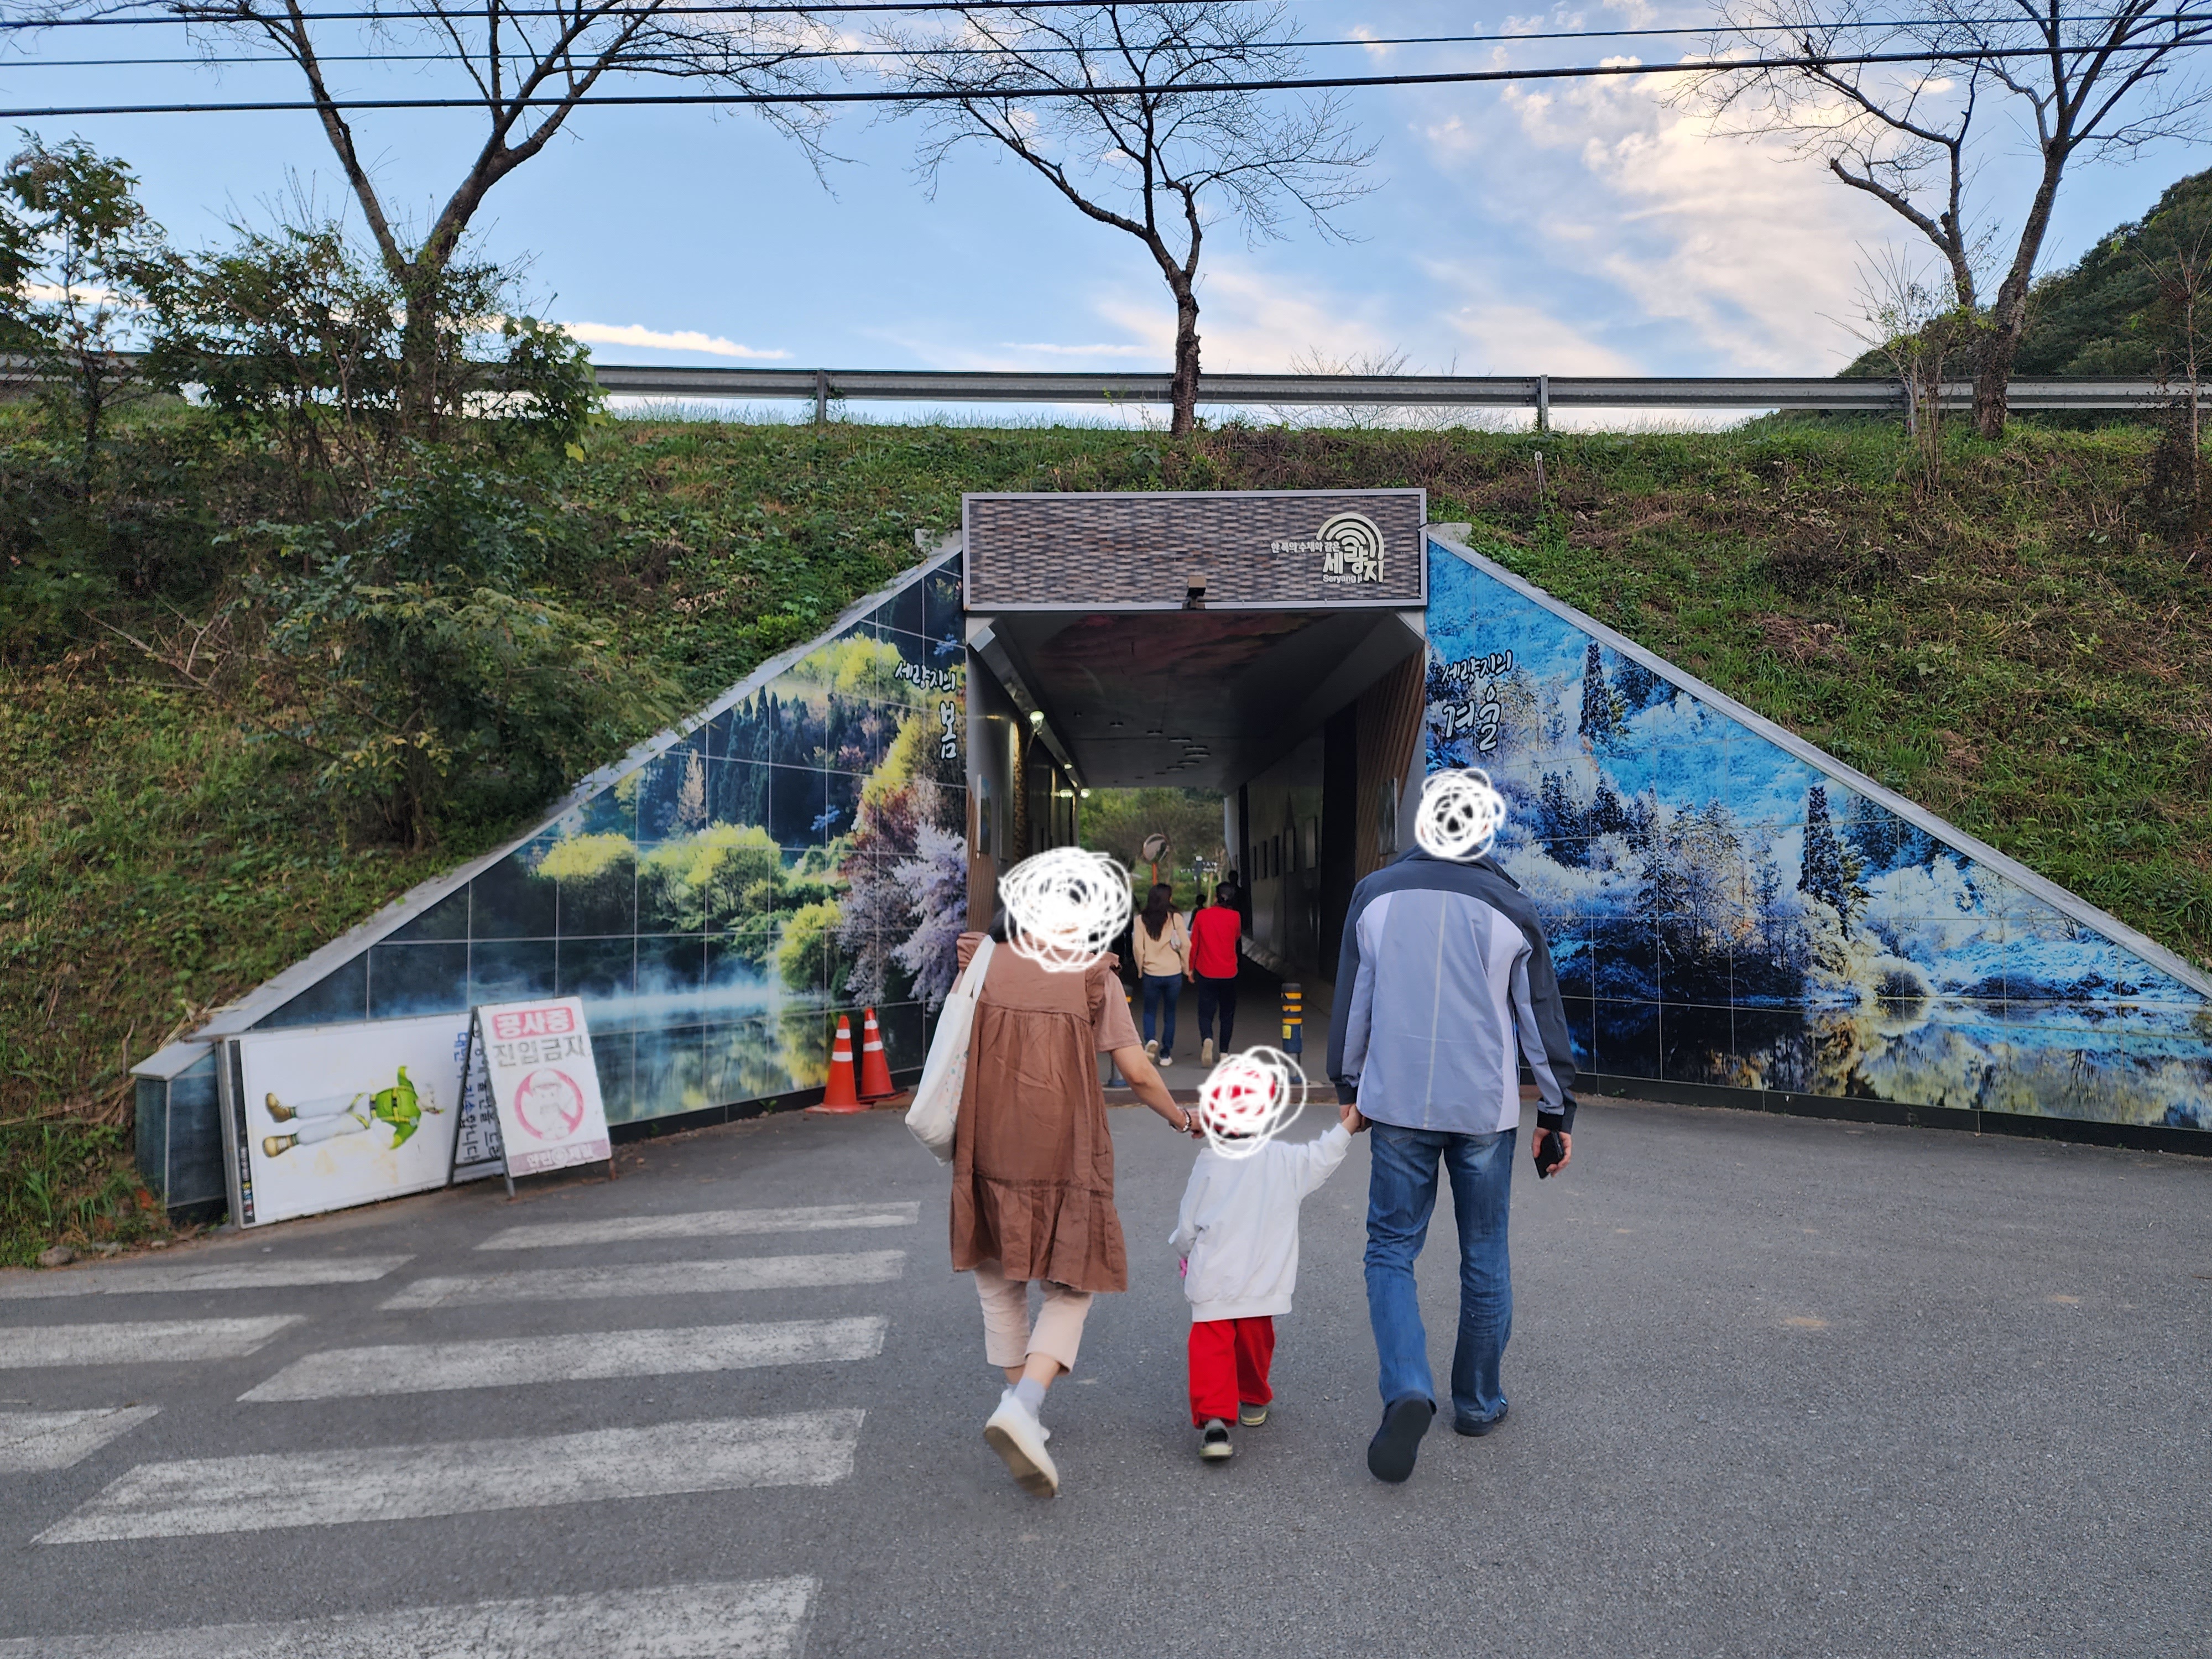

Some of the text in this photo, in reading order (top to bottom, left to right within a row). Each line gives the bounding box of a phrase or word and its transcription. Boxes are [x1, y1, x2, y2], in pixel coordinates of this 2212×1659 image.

[1271, 541, 1280, 554] 한
[1323, 545, 1384, 583] 세량지
[894, 661, 957, 692] 세량지의
[1441, 650, 1513, 684] 세량지의
[940, 701, 957, 760] 봄
[1442, 684, 1501, 752] 겨울
[496, 1008, 570, 1039] 공사중
[492, 1035, 586, 1068] 진입금지
